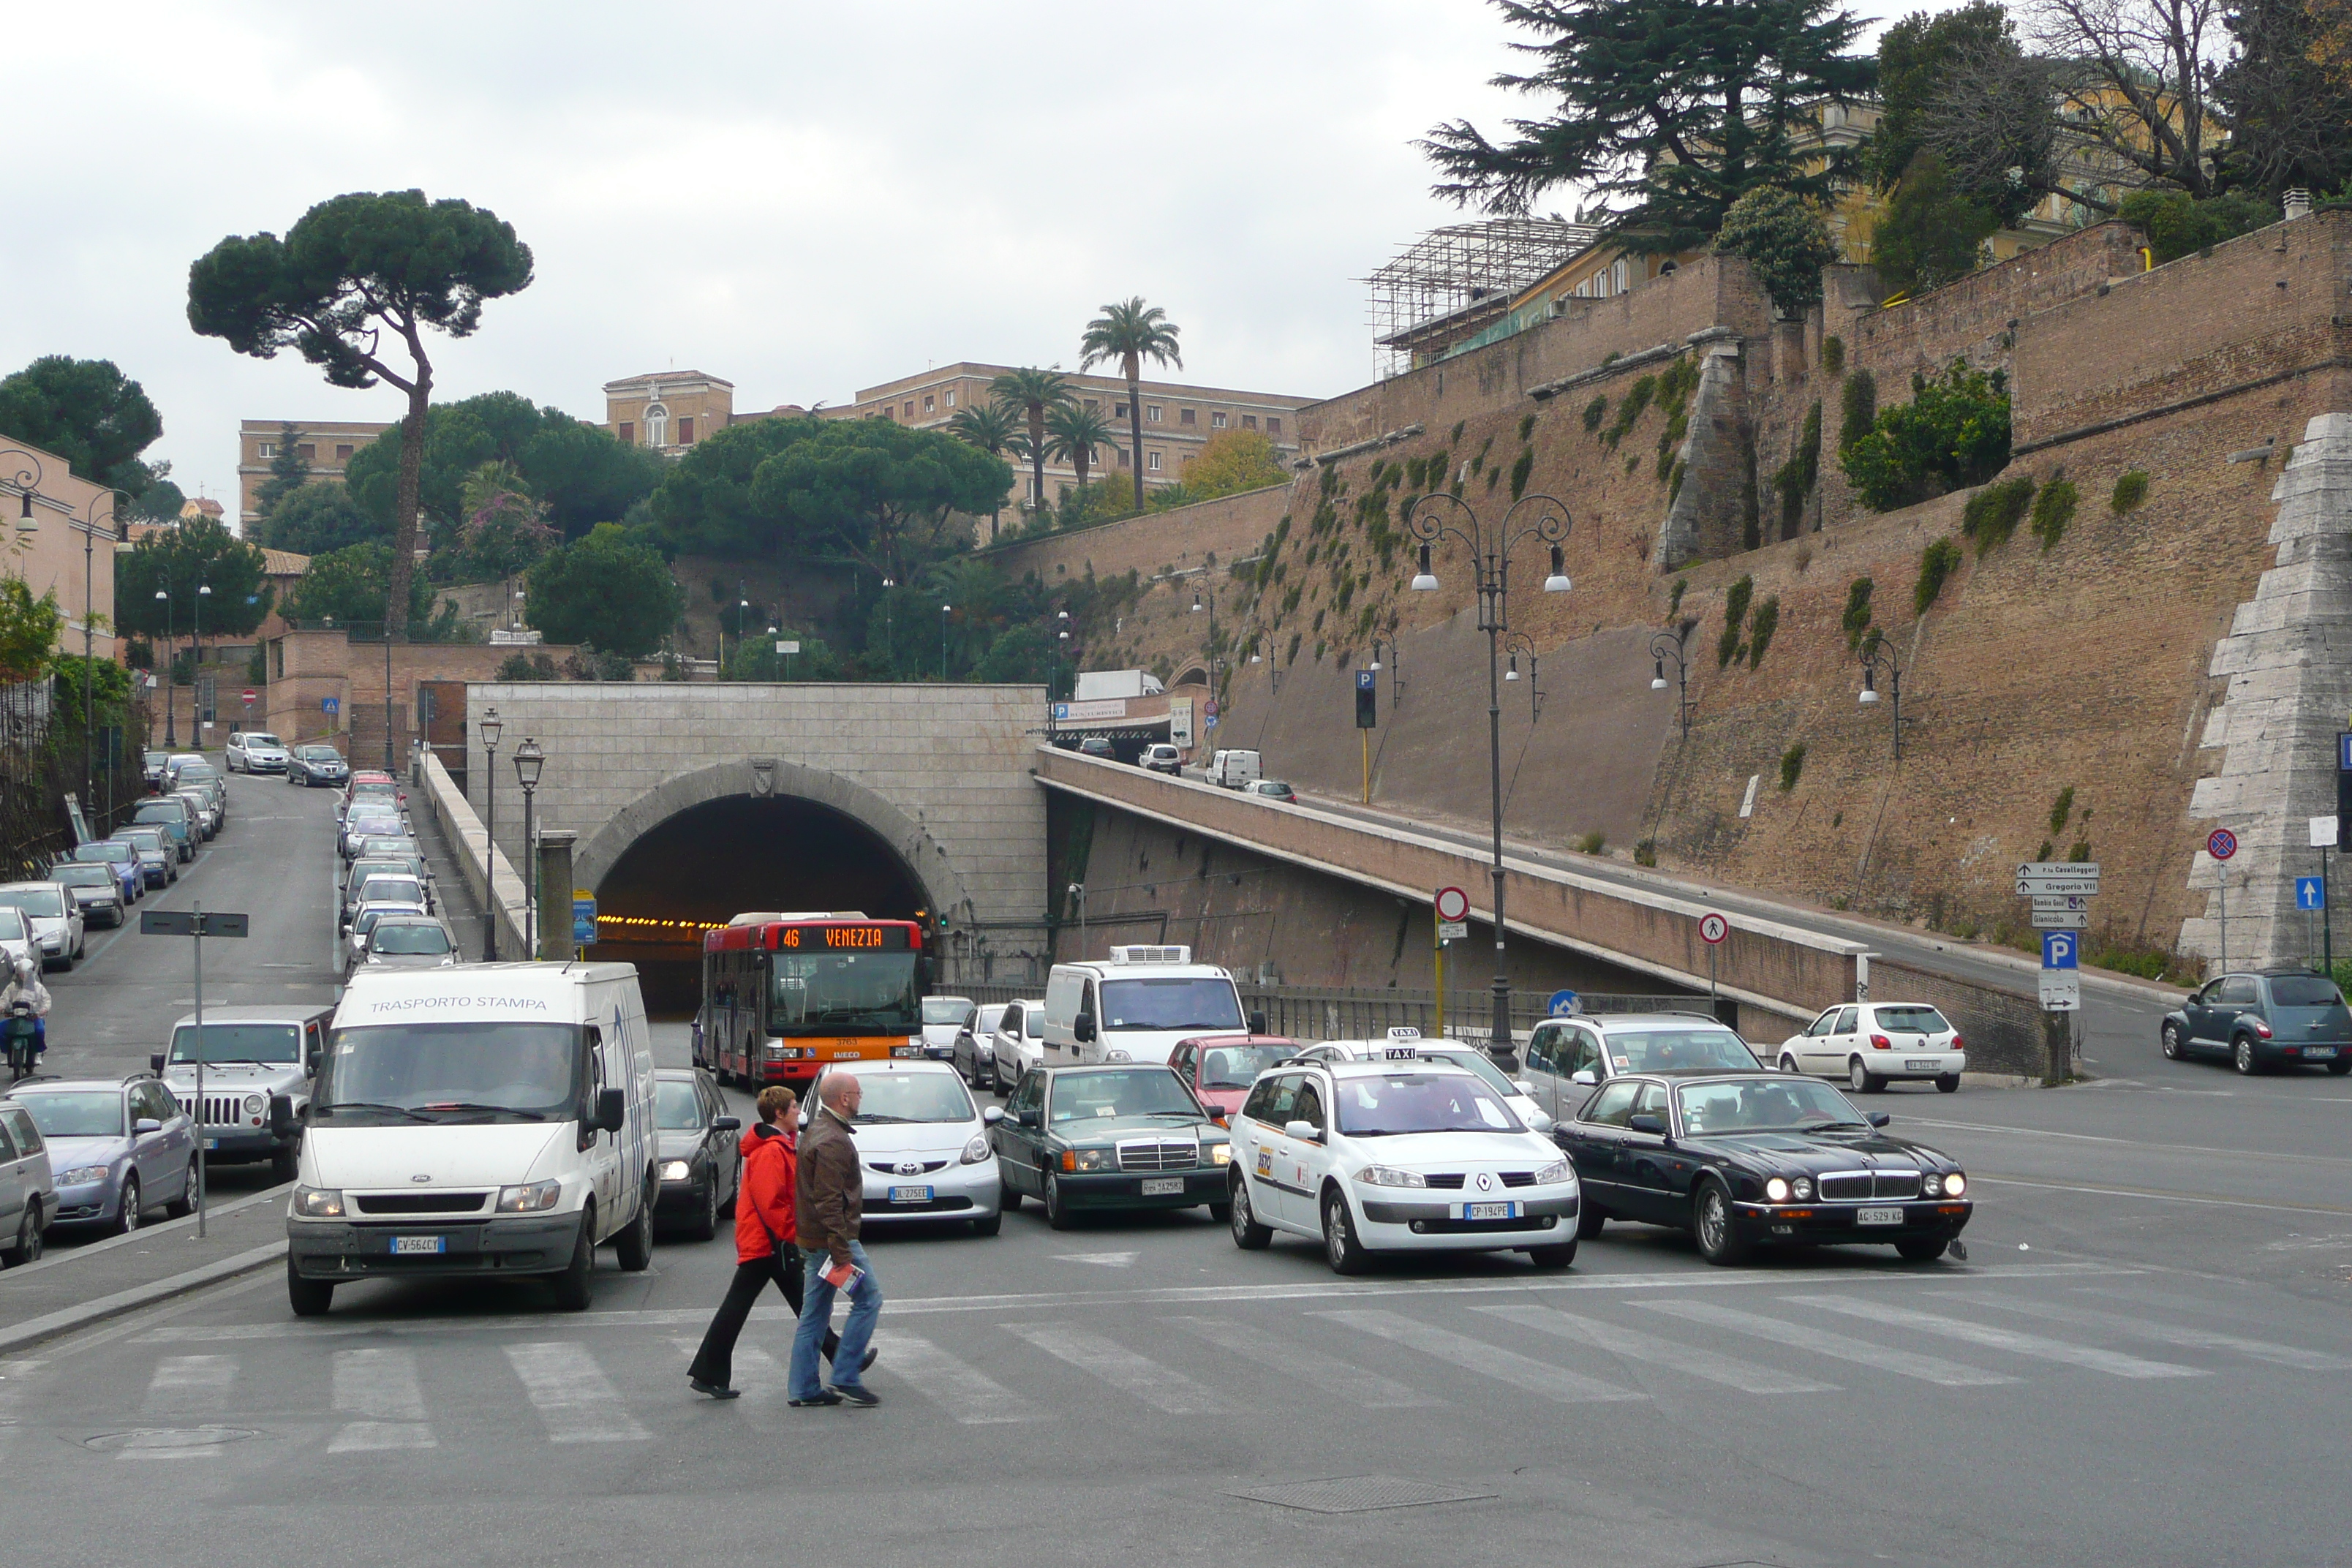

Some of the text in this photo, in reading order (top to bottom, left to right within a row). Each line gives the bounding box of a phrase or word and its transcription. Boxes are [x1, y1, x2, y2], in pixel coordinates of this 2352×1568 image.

[1361, 674, 1371, 685] P
[1058, 707, 1065, 717] P
[2054, 866, 2097, 875] Cavalleggeri
[2046, 882, 2096, 891] Gregorio VII
[2033, 914, 2064, 923] Gianicolo
[783, 928, 882, 947] 46 VENEZIA
[2051, 941, 2069, 965] P
[371, 996, 547, 1013] TRASPORTO STAMPA
[1391, 1028, 1417, 1036] TAXI
[1386, 1049, 1414, 1059] TAXI
[1258, 1151, 1271, 1171] 3570
